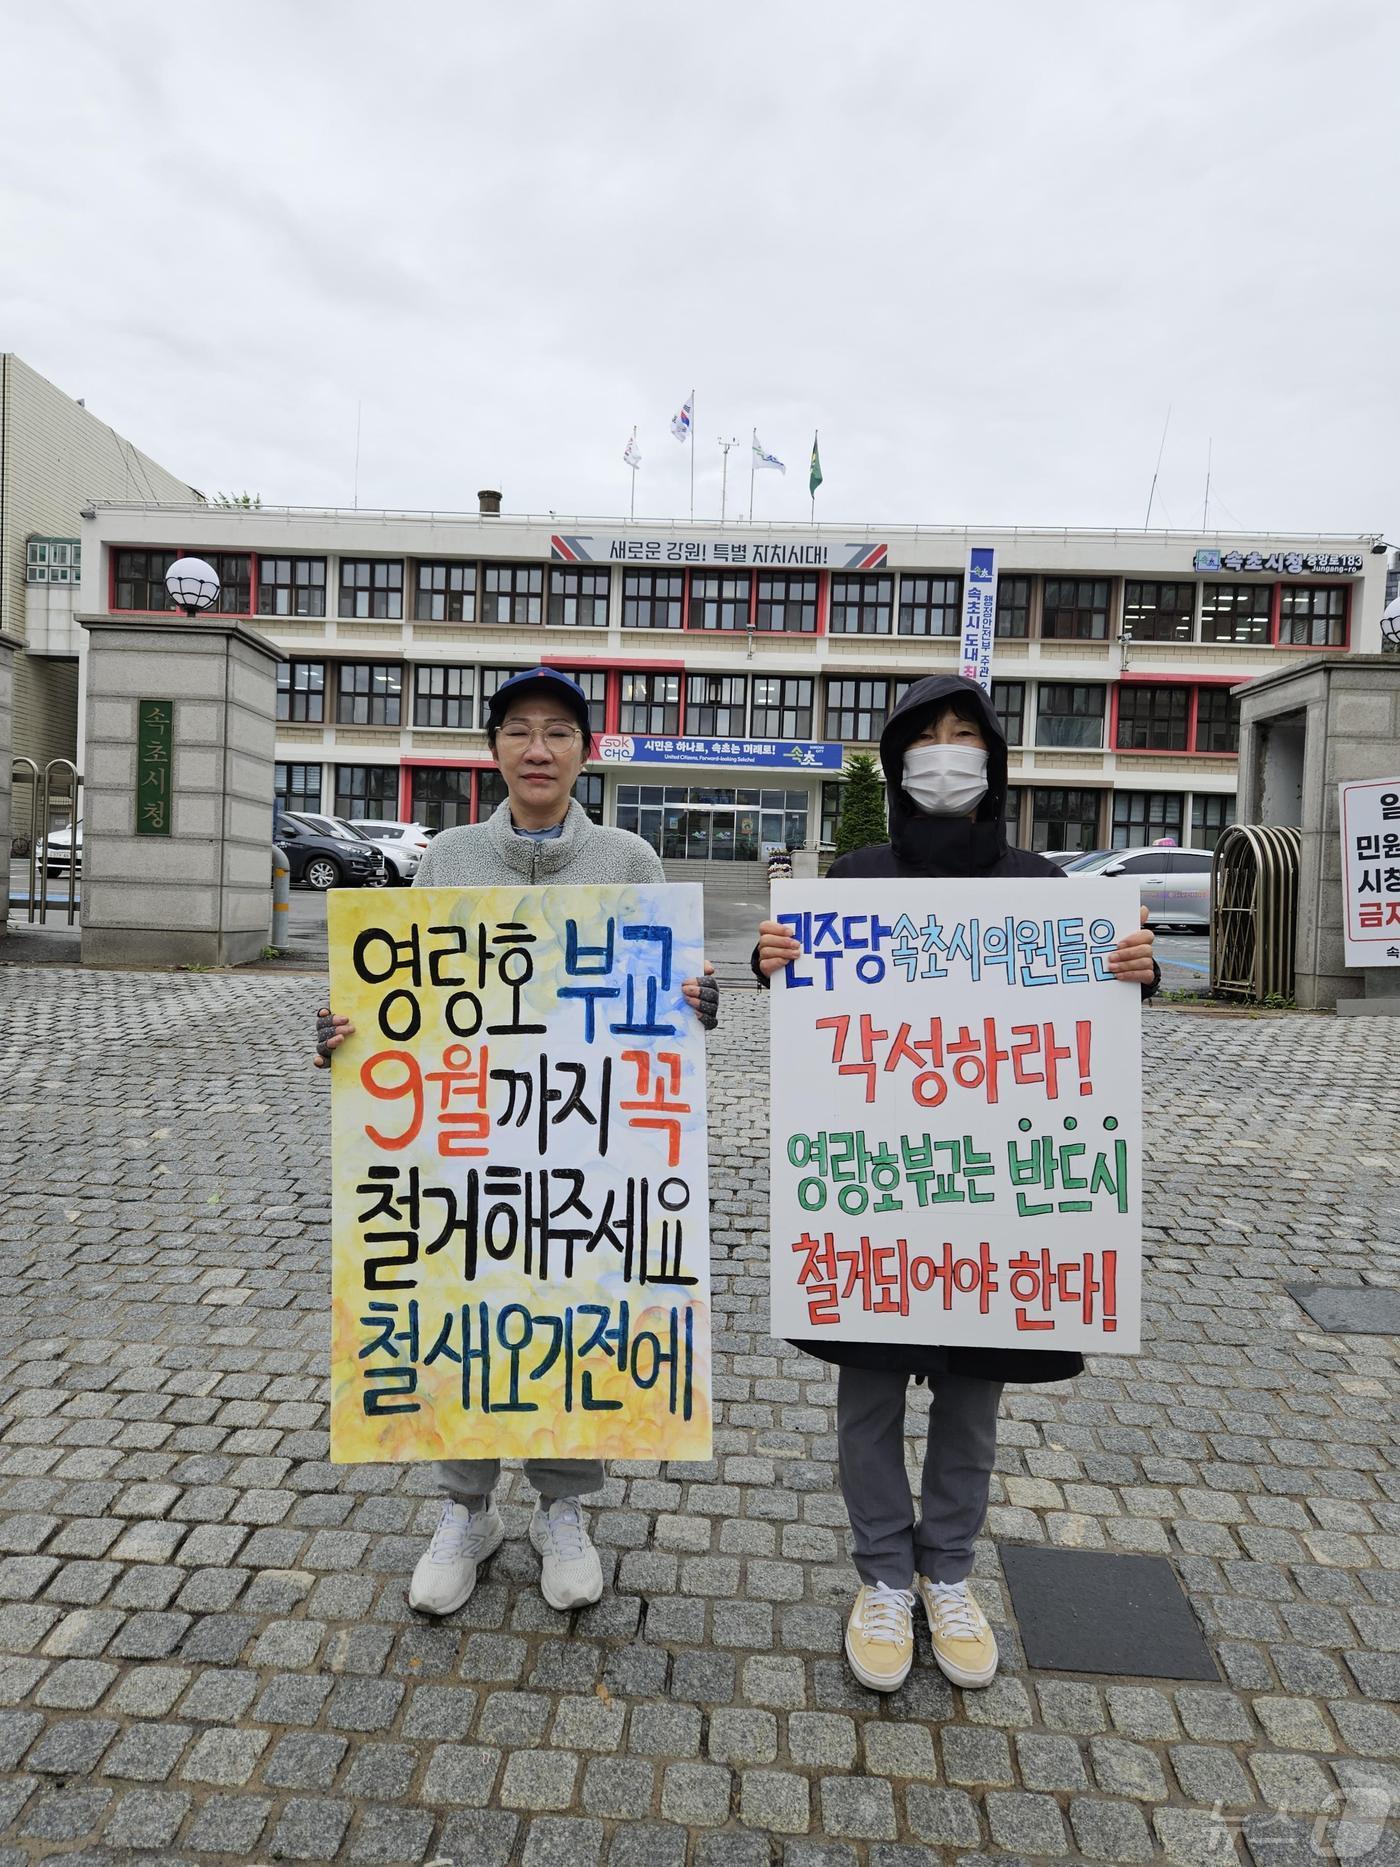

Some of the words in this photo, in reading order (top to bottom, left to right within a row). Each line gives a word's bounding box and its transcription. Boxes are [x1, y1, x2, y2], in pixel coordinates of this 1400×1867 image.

[610, 540, 661, 560] 새로운
[667, 542, 706, 562] 강원!
[713, 544, 747, 563] 특별
[752, 544, 828, 564] 자치시대!
[1224, 551, 1303, 573] 속초시청
[966, 587, 981, 630] 속초시
[981, 595, 993, 651] 행정안전부
[964, 634, 979, 662] 도내
[980, 655, 989, 678] 주관
[142, 707, 170, 828] 속초시청
[644, 740, 674, 752] 시민은
[676, 742, 709, 754] 하나로,
[711, 742, 741, 754] 속초는
[743, 744, 776, 755] 미래로!
[353, 922, 547, 1041] 영랑호
[556, 917, 677, 1043] 부교
[816, 1014, 1093, 1108] 각성하라!
[1007, 1133, 1129, 1217] 반드시
[791, 1232, 999, 1326] 철거되어야
[1008, 1247, 1118, 1333] 한다!
